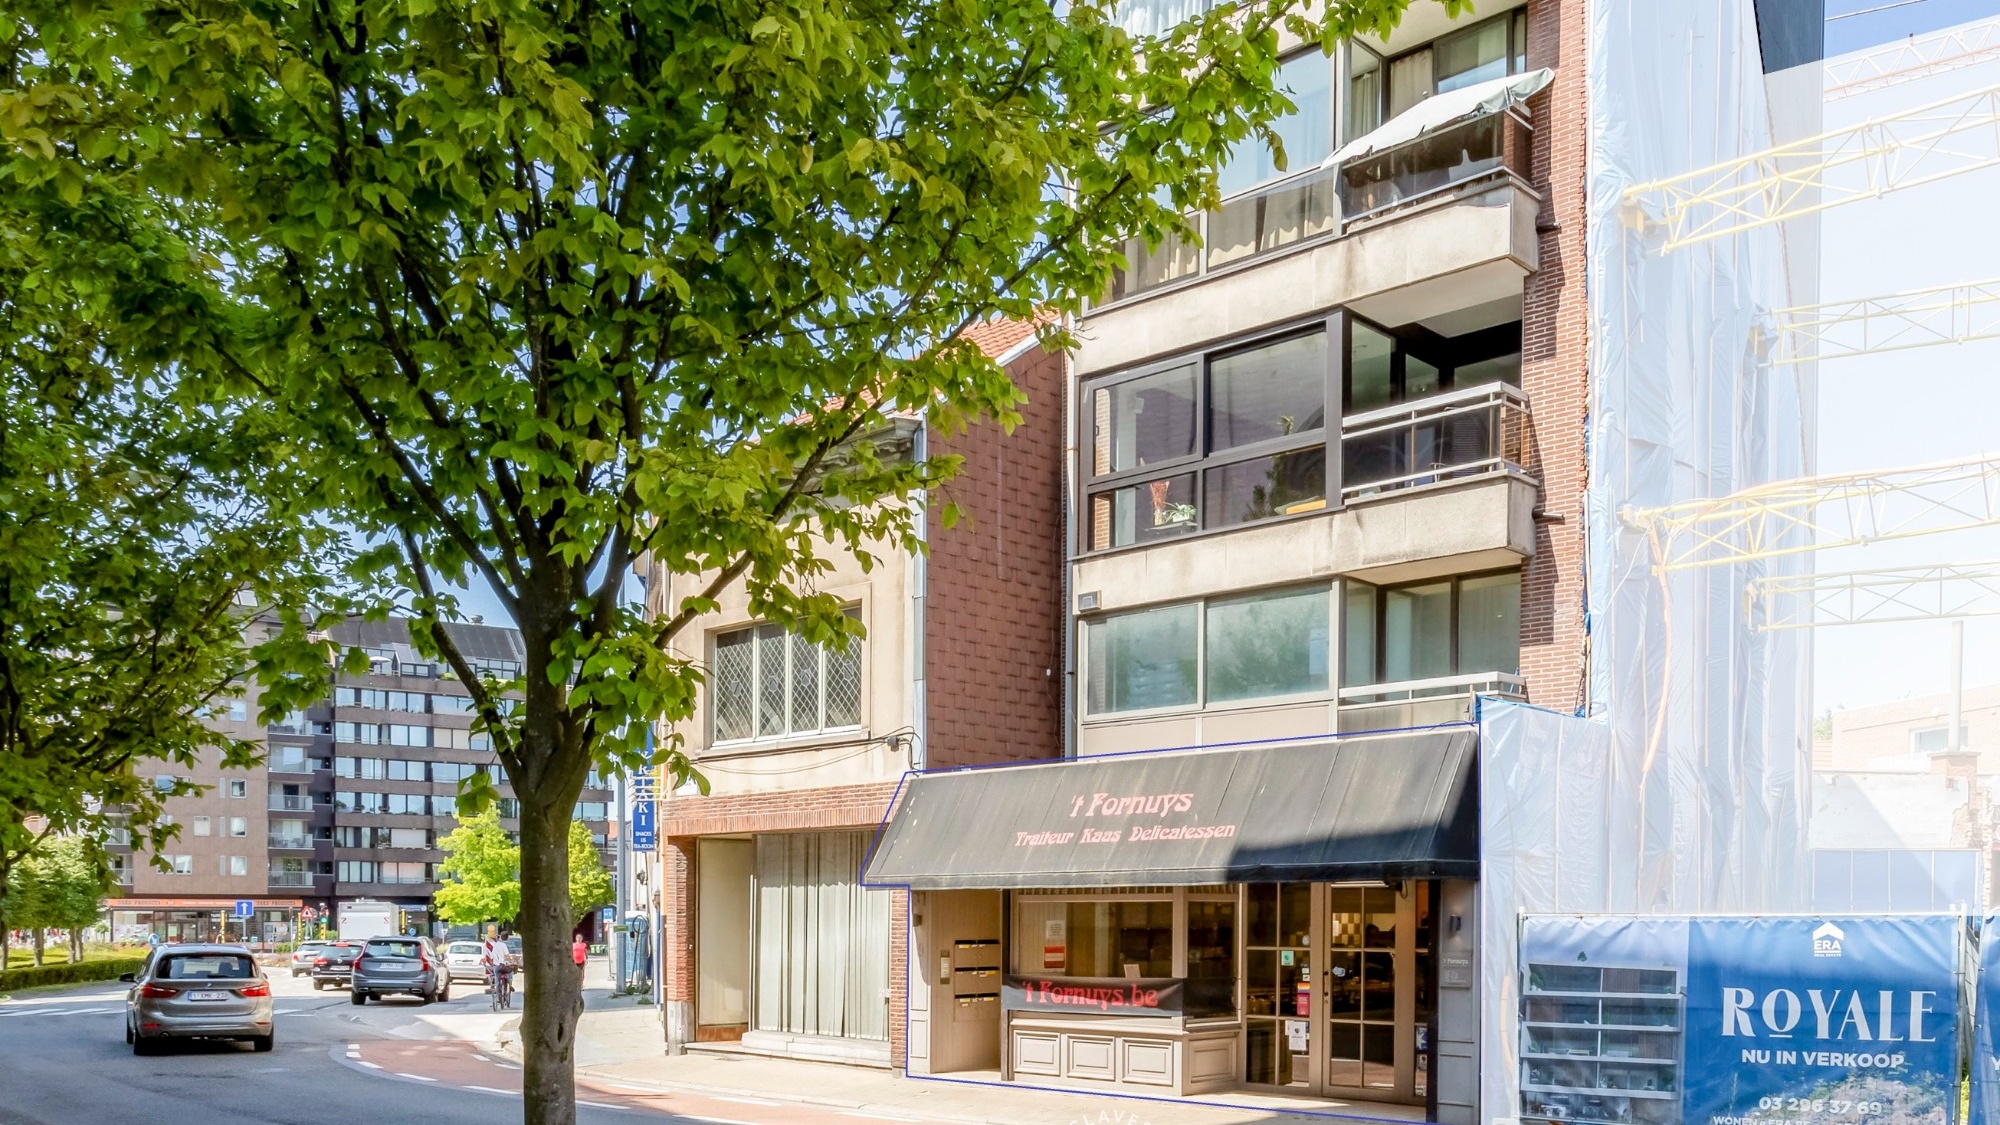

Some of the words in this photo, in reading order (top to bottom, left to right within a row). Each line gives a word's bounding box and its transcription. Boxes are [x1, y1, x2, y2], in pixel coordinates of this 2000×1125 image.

[1085, 792, 1194, 817] Fornuys
[1015, 831, 1074, 846] Traiteur
[1080, 829, 1122, 844] Kaas
[1128, 825, 1236, 842] Delicatessen
[1814, 940, 1841, 950] ERA
[1039, 980, 1159, 1010] Fornuys.be
[1721, 987, 1937, 1043] ROYALE
[1741, 1049, 1771, 1064] NU
[1776, 1050, 1796, 1065] IN
[1801, 1051, 1905, 1069] VERKOOP
[1758, 1096, 1782, 1111] 03
[1787, 1097, 1825, 1113] 296
[1828, 1099, 1852, 1114] 37
[1856, 1101, 1883, 1116] 69
